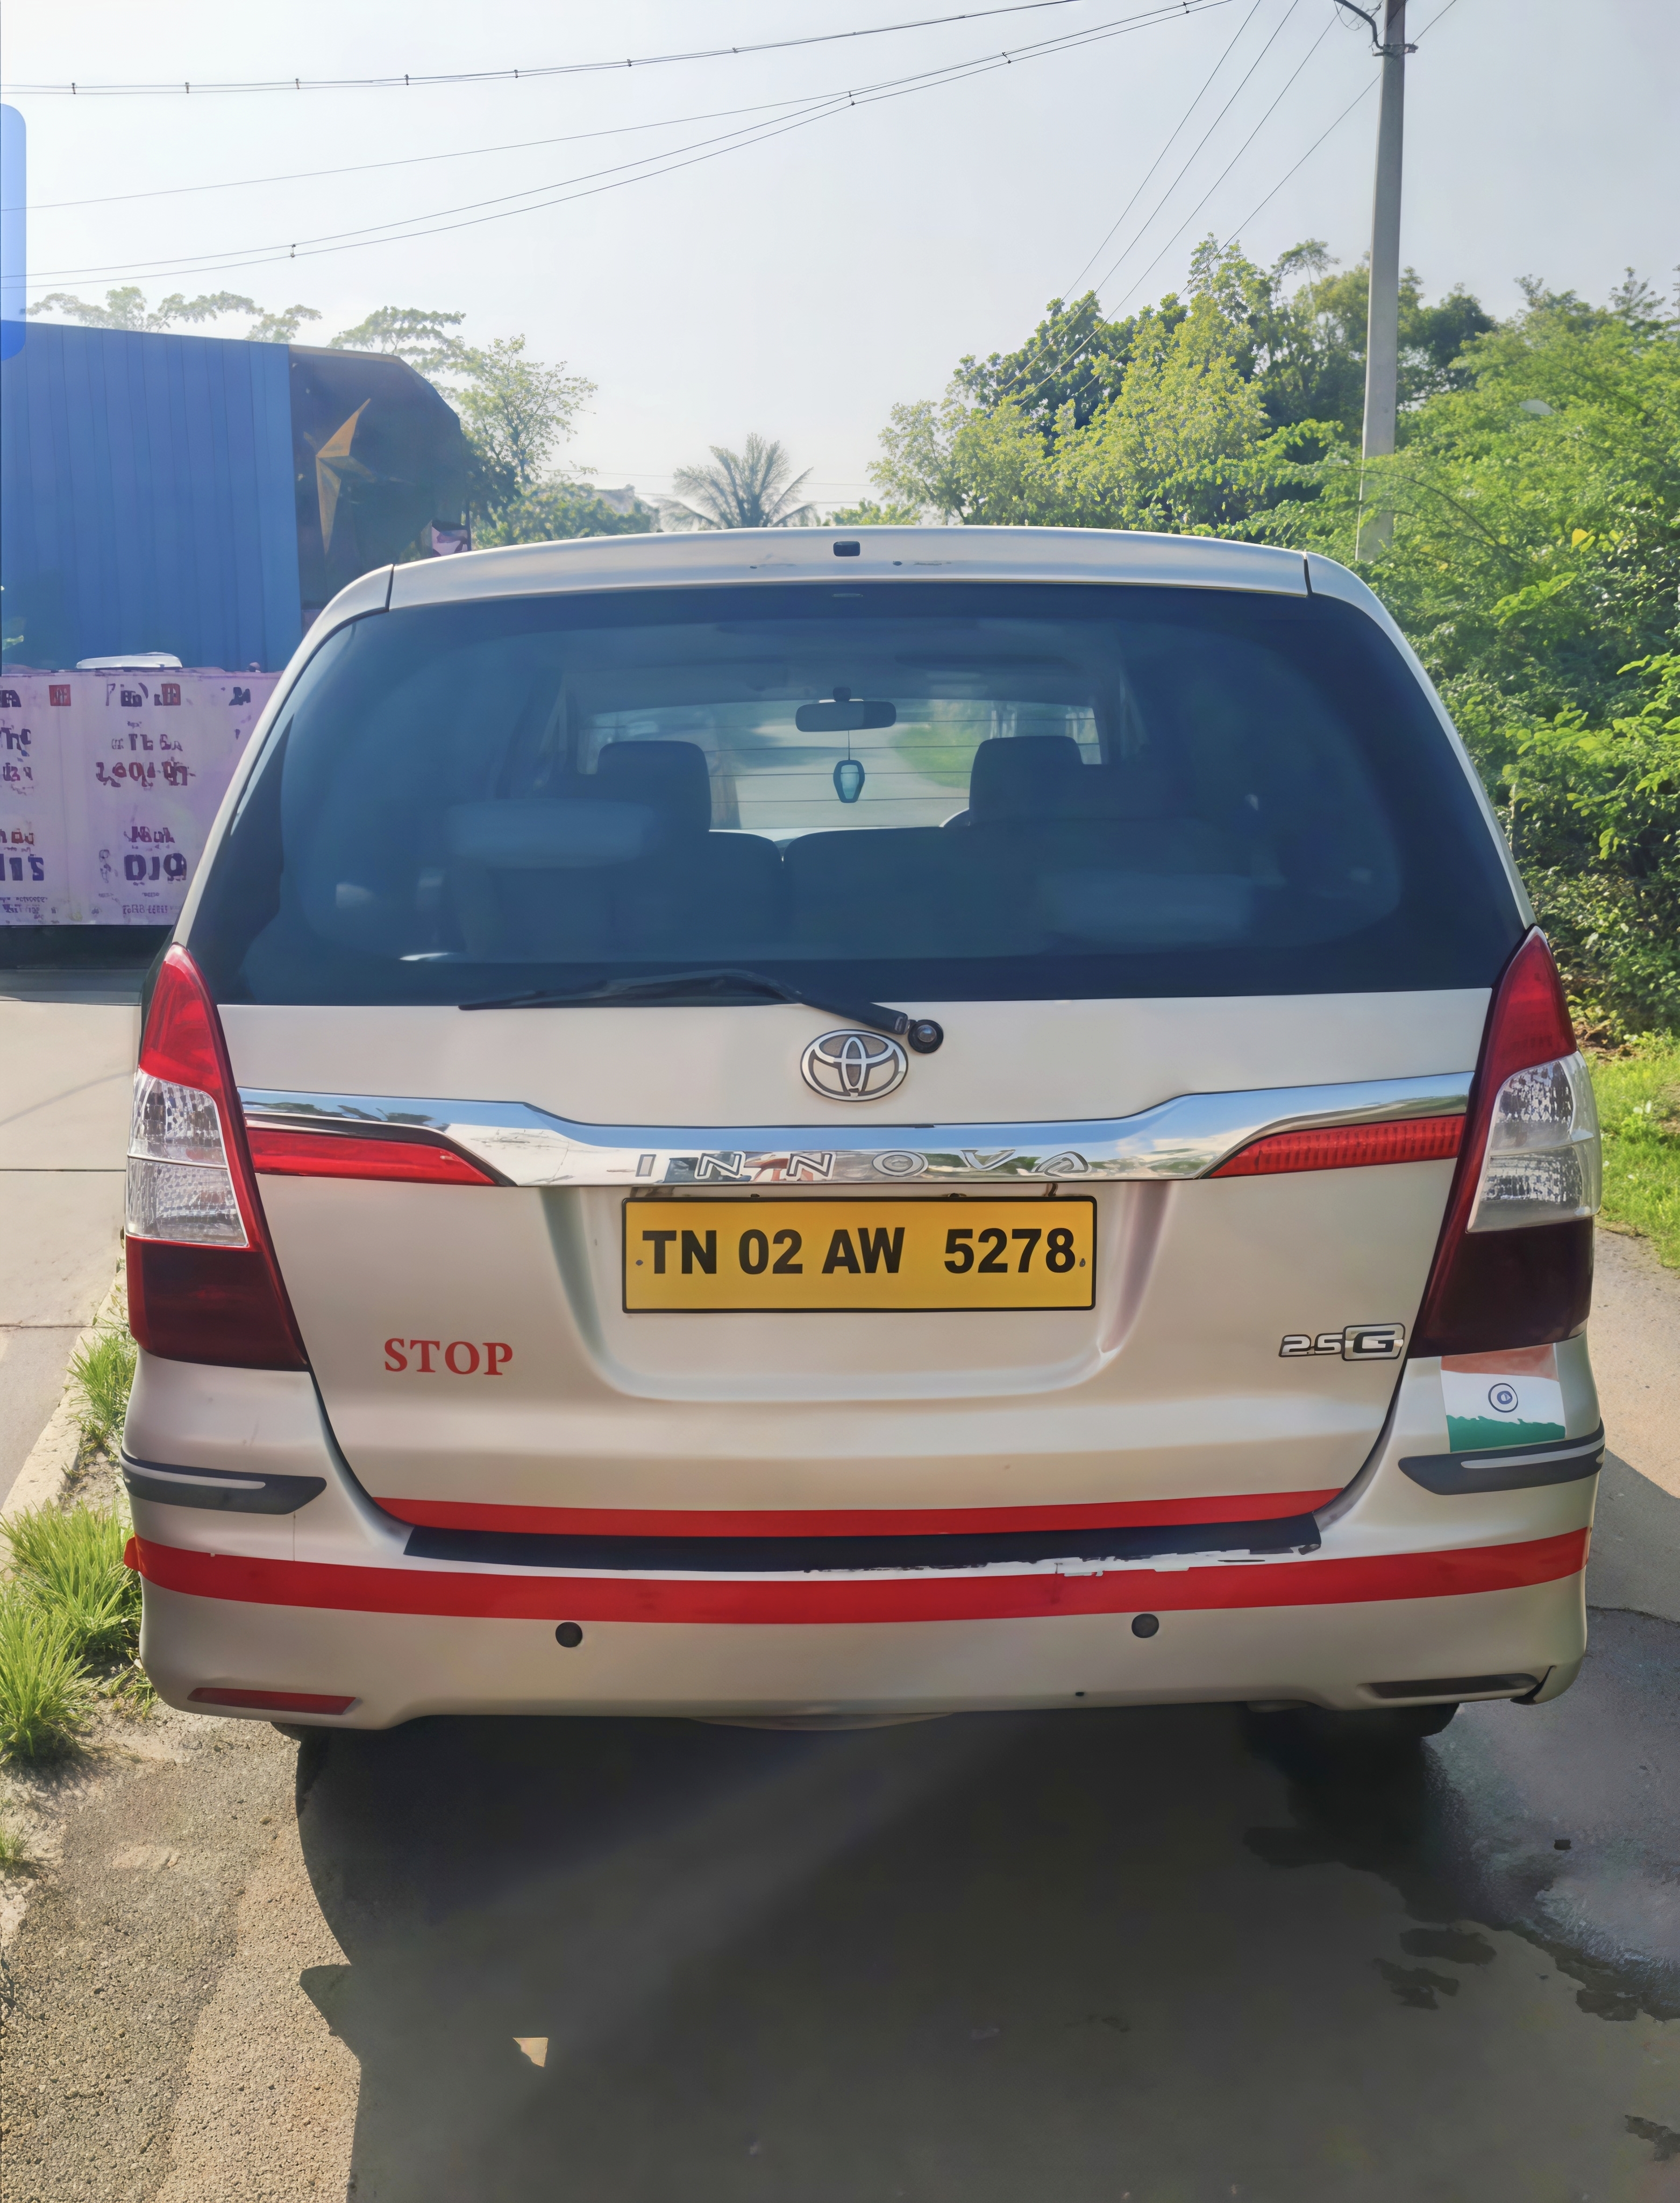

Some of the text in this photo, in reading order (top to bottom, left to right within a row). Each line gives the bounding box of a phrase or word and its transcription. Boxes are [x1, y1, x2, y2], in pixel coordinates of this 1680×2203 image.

[635, 1149, 1091, 1181] INNOVA
[642, 1227, 1076, 1275] TN 02 AW 5278
[384, 1338, 513, 1375] STOP
